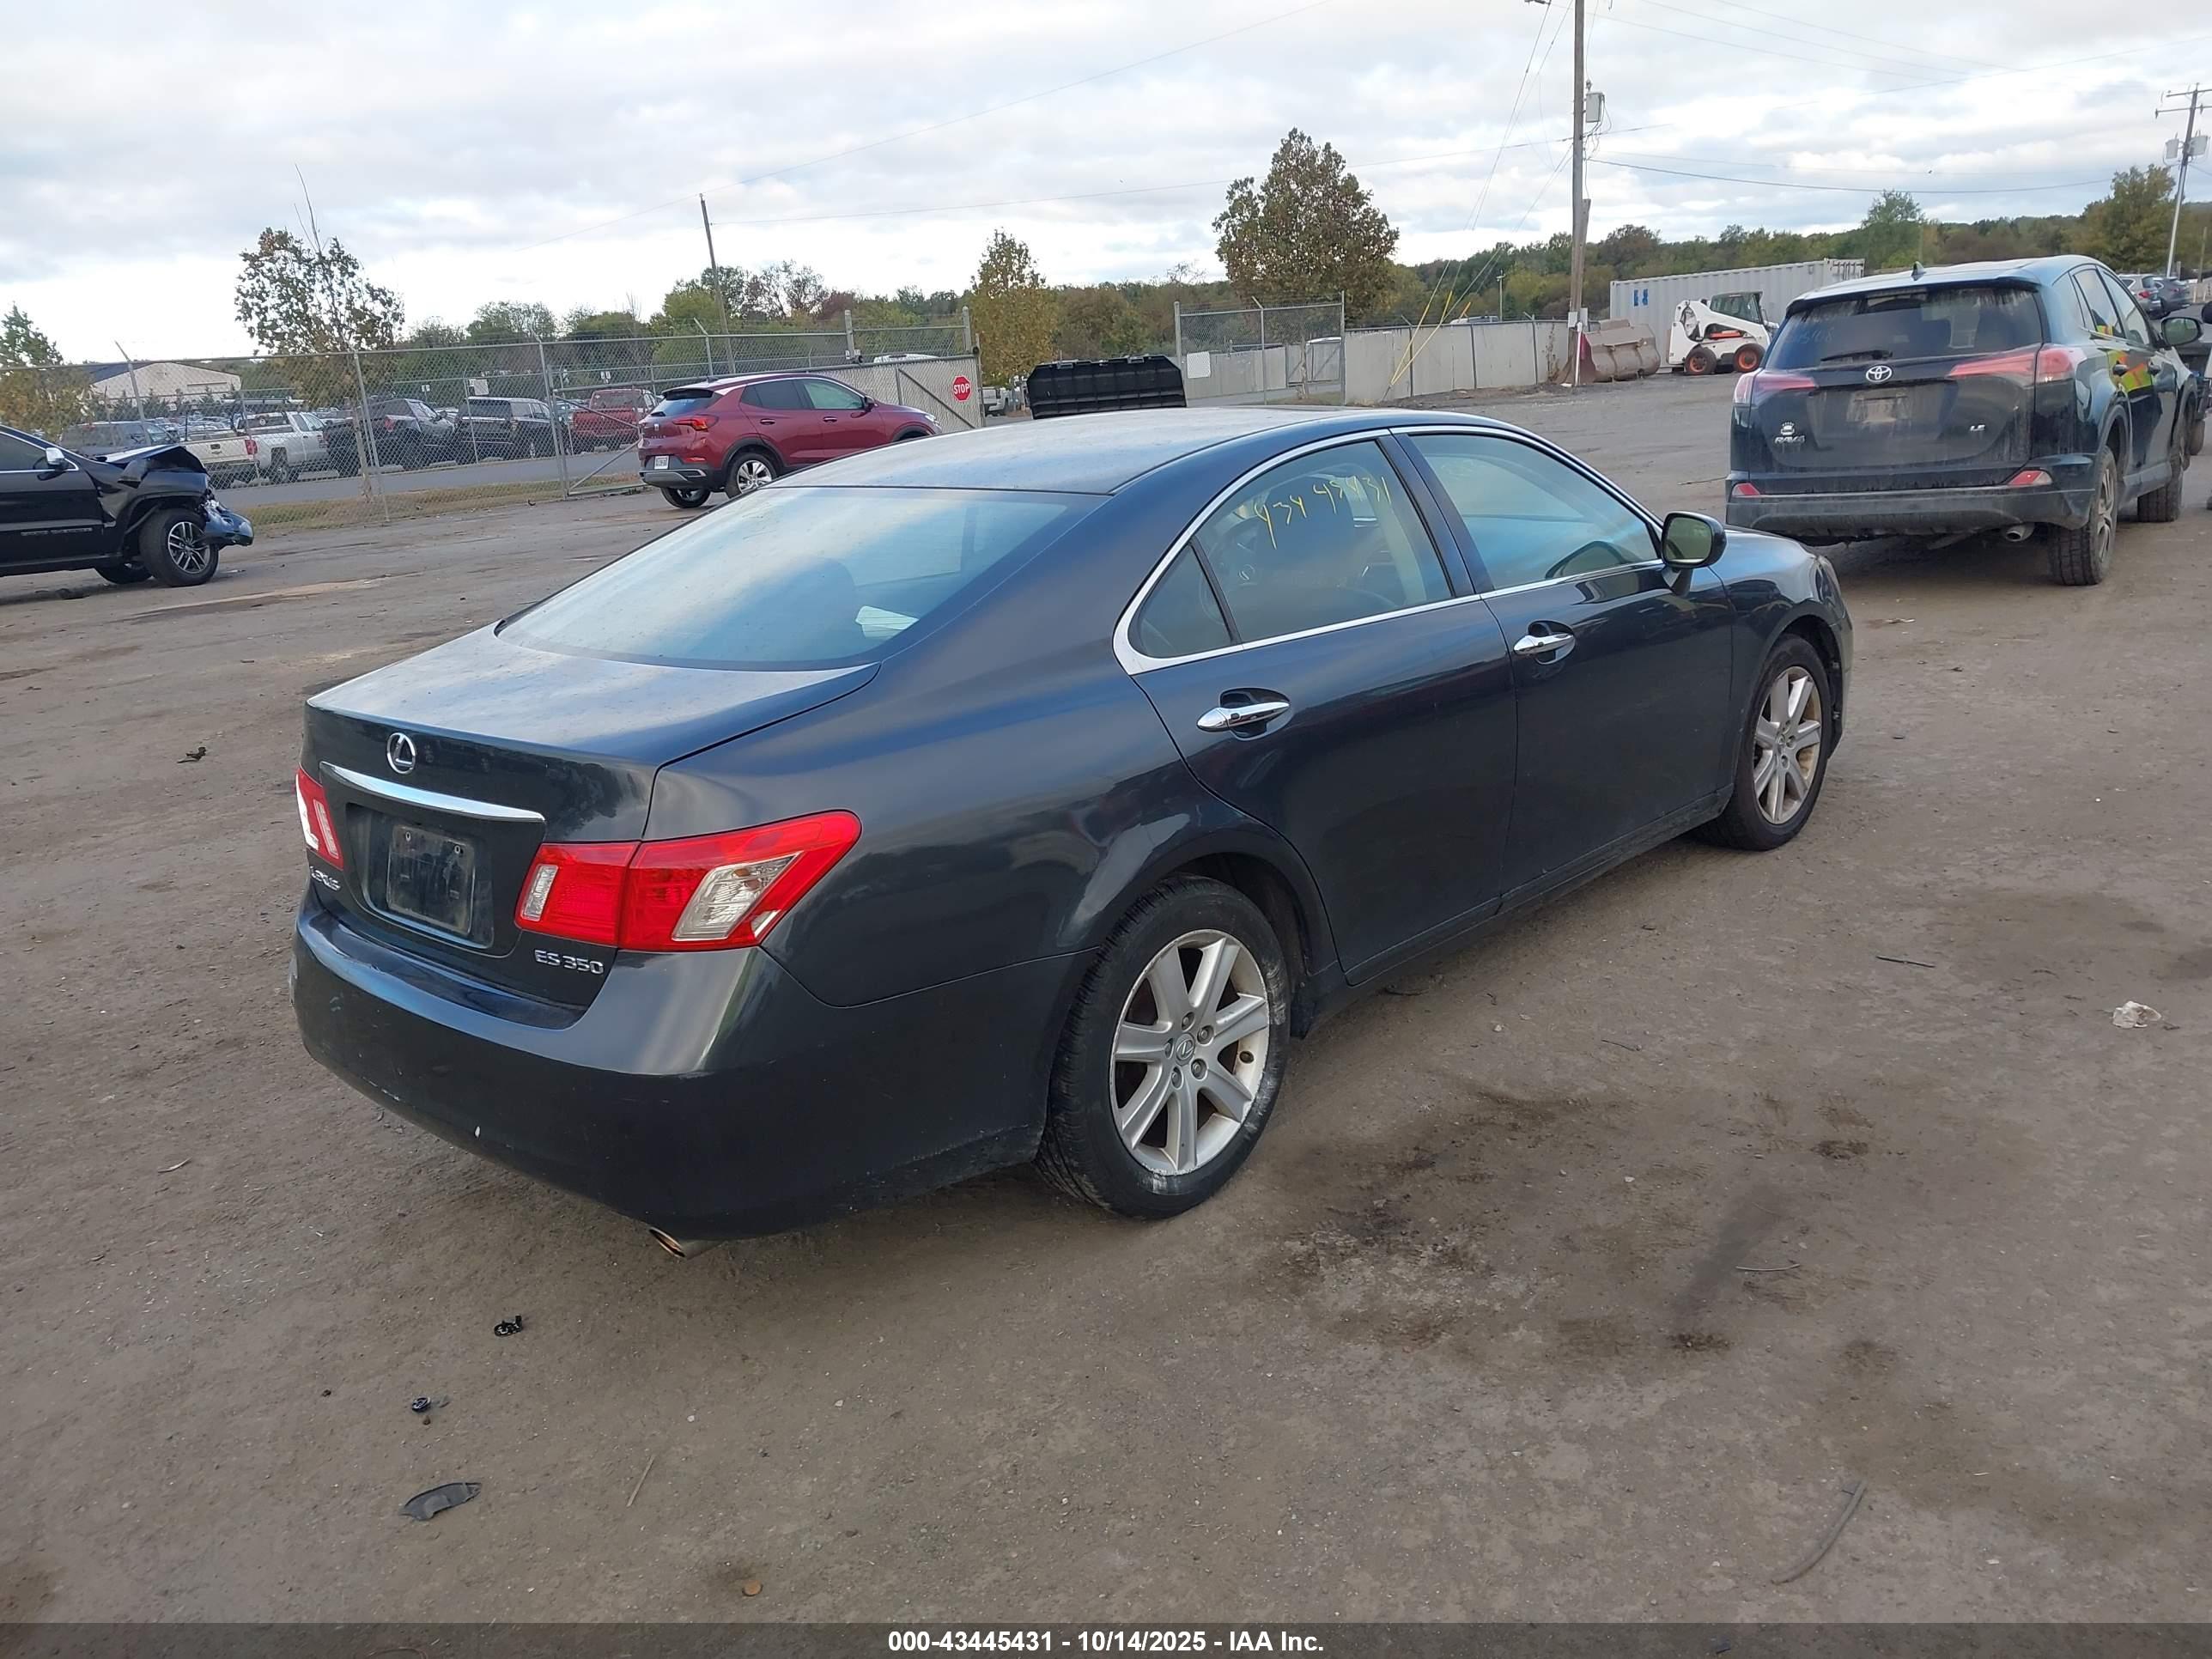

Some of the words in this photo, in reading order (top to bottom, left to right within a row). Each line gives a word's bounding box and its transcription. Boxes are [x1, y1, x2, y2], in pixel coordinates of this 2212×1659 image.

[953, 383, 970, 395] STOP
[1774, 435, 1806, 444] RAV4
[534, 950, 561, 966] ES
[562, 955, 605, 975] 350
